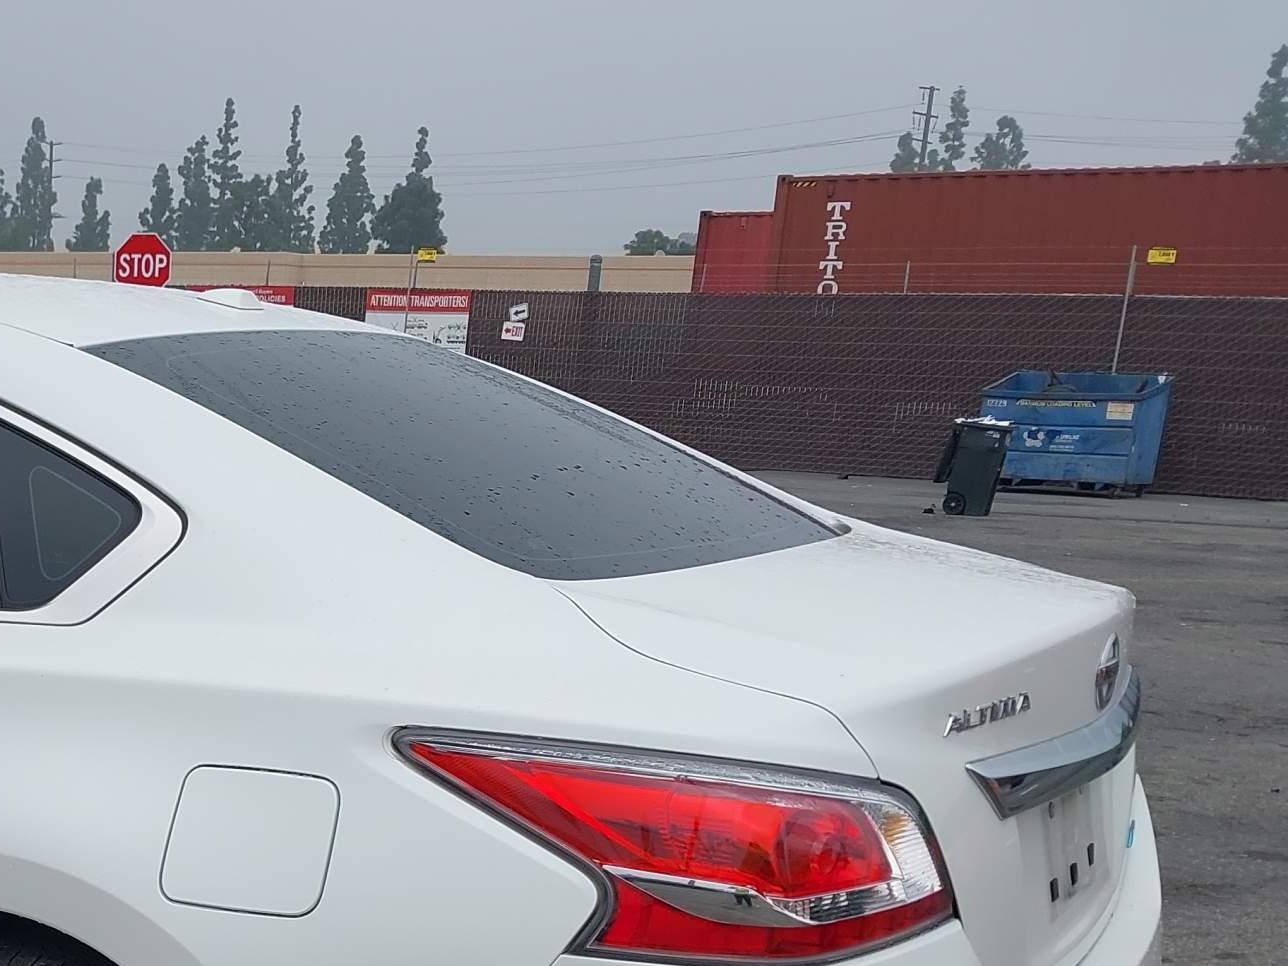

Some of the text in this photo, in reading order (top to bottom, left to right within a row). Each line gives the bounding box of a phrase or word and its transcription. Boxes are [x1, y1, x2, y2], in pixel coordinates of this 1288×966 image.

[816, 201, 852, 295] TRITO
[118, 253, 168, 278] STOP
[370, 294, 408, 307] ATTENTION
[410, 295, 469, 308] TRANSPORTERS!
[511, 325, 524, 338] EXIT
[942, 690, 1032, 738] ALTIMA
